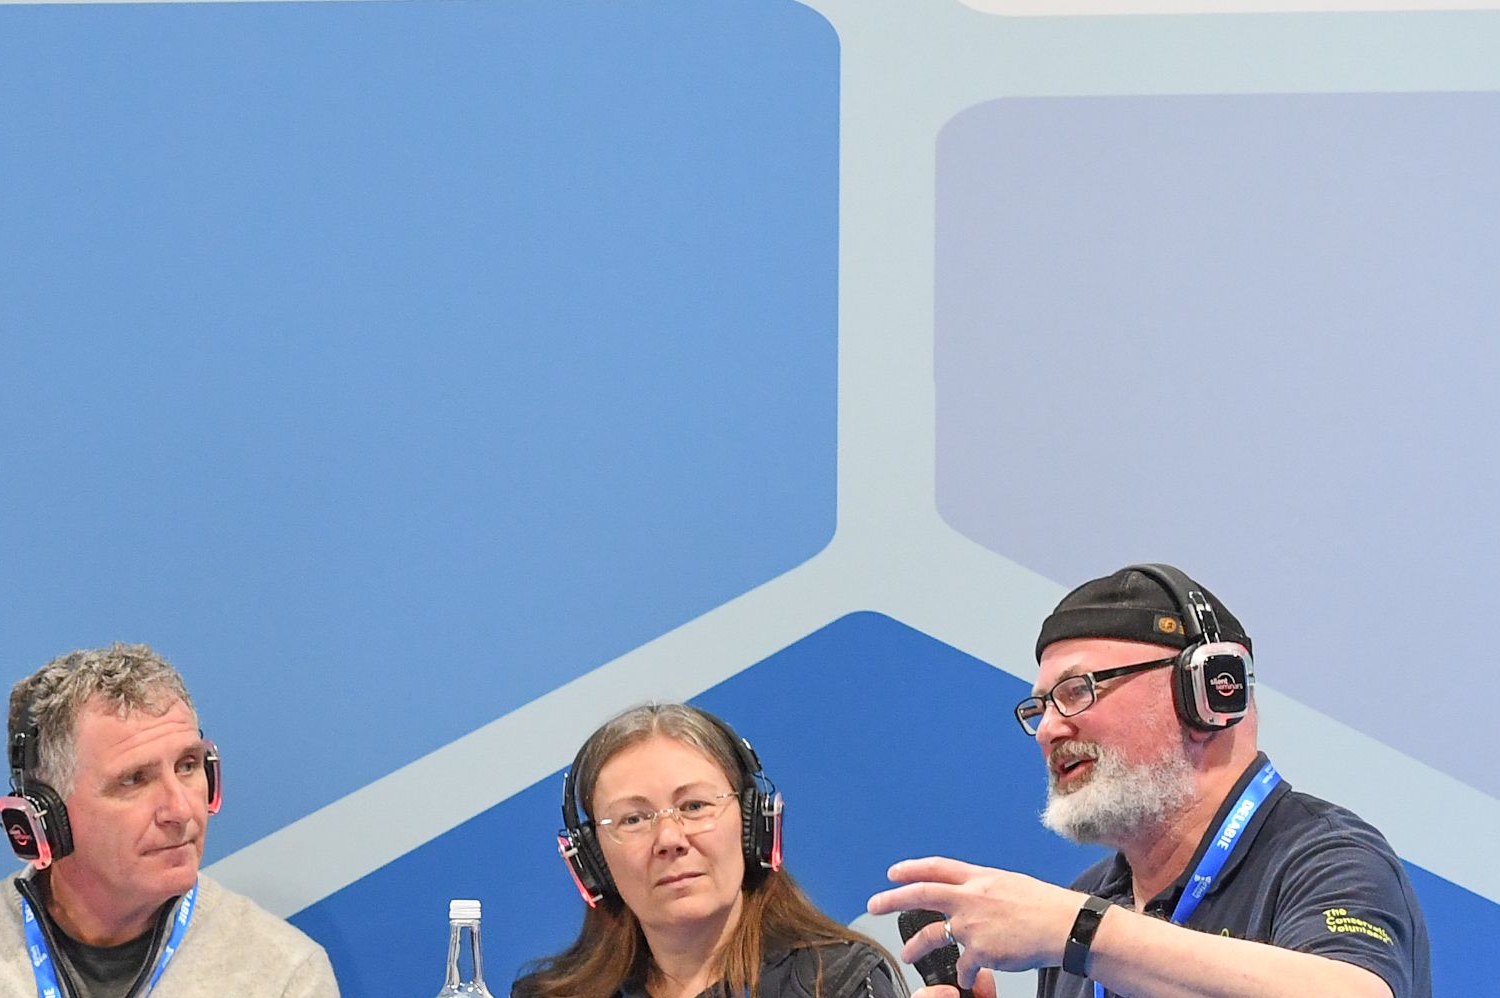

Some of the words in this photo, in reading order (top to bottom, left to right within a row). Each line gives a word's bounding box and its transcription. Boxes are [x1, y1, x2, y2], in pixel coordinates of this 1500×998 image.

[1217, 799, 1254, 851] DELABIE
[178, 888, 195, 926] LABIE
[1323, 908, 1347, 918] The
